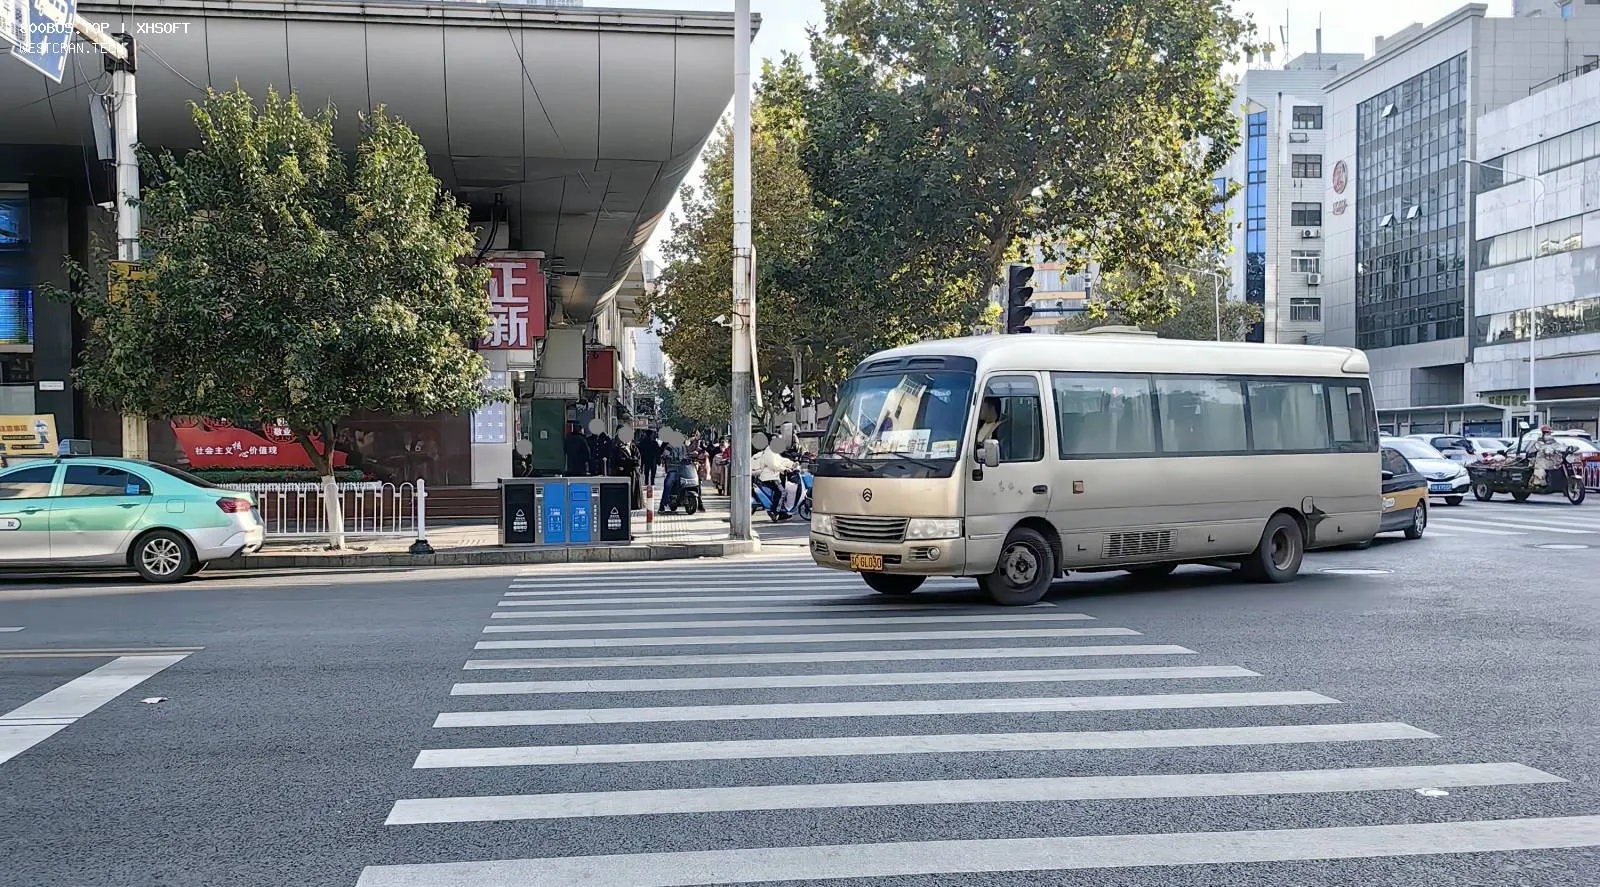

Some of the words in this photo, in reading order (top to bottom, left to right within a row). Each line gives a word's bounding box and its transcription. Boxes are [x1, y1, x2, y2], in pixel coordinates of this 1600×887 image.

[484, 262, 529, 347] 正新
[195, 441, 278, 458] 社会主义核心价值观
